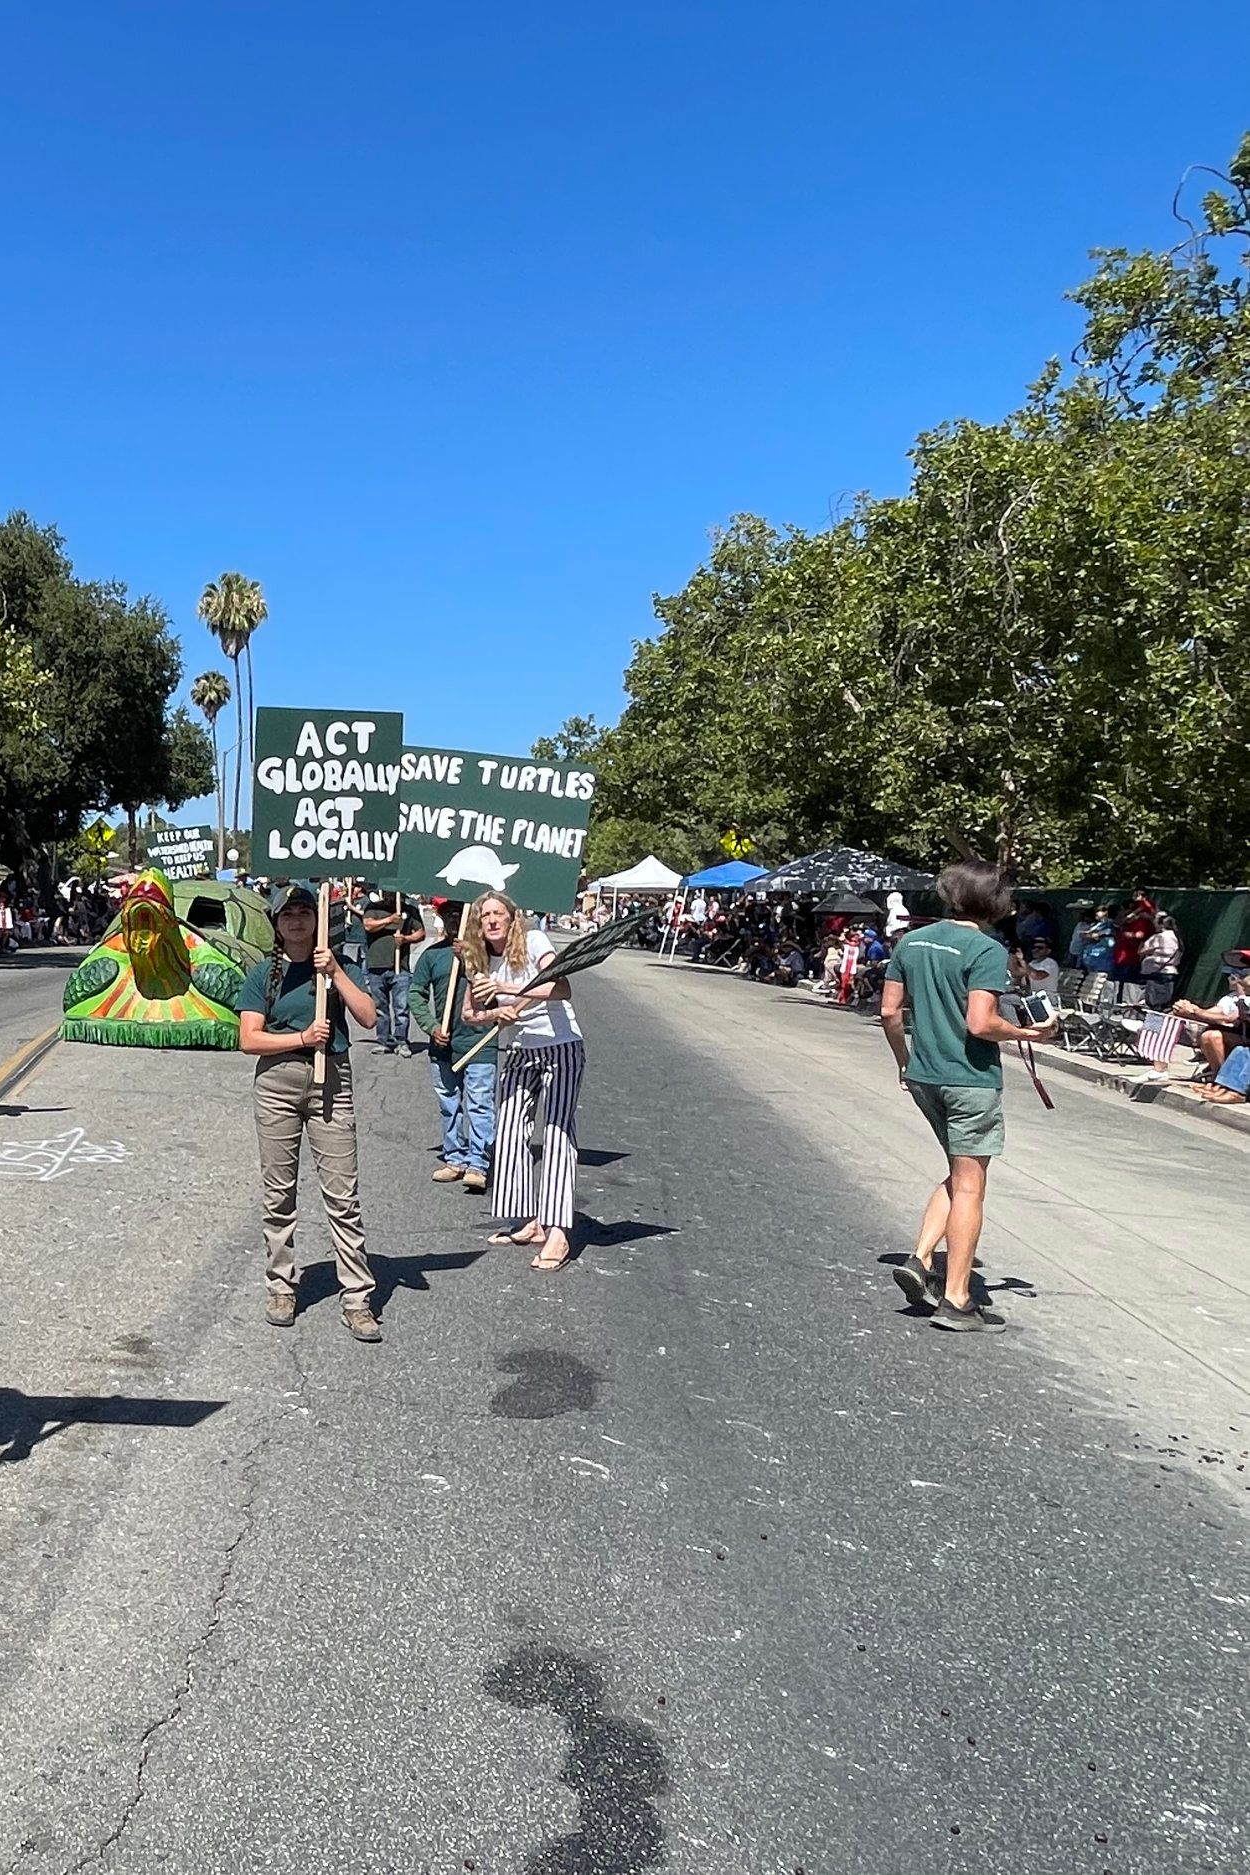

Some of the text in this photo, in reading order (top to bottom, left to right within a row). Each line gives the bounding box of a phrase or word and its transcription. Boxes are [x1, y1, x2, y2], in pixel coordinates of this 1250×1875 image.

[296, 721, 376, 758] ACT
[257, 756, 400, 796] GLOBALLY
[400, 753, 596, 800] SAVE TURTLES
[294, 797, 364, 830] ACT
[157, 830, 181, 843] KEEP
[269, 829, 398, 862] LOCALLY
[459, 809, 506, 845] THE
[511, 818, 587, 858] PLANET
[161, 855, 173, 865] TO
[193, 850, 206, 861] US
